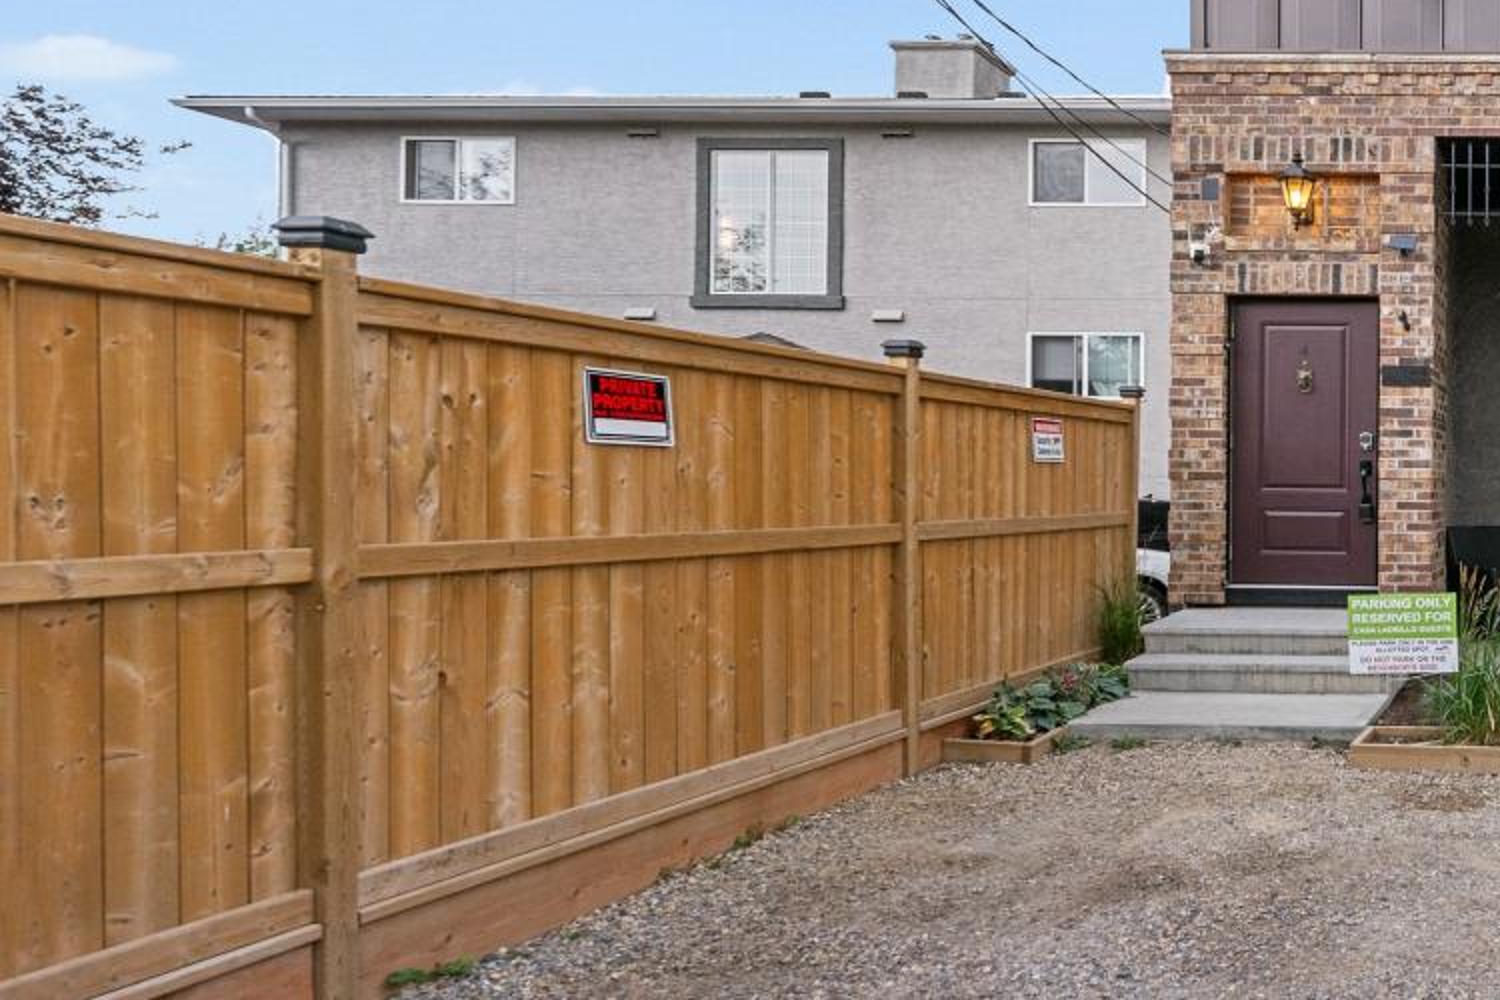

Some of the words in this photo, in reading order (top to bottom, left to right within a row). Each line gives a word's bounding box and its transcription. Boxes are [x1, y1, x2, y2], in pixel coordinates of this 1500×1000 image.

[599, 377, 657, 397] PRIVATE
[593, 393, 664, 413] PROPERTY
[1352, 598, 1411, 609] PARKING
[1415, 597, 1451, 609] ONLY
[1352, 612, 1422, 623] RESERVED
[1425, 611, 1451, 622] FOR
